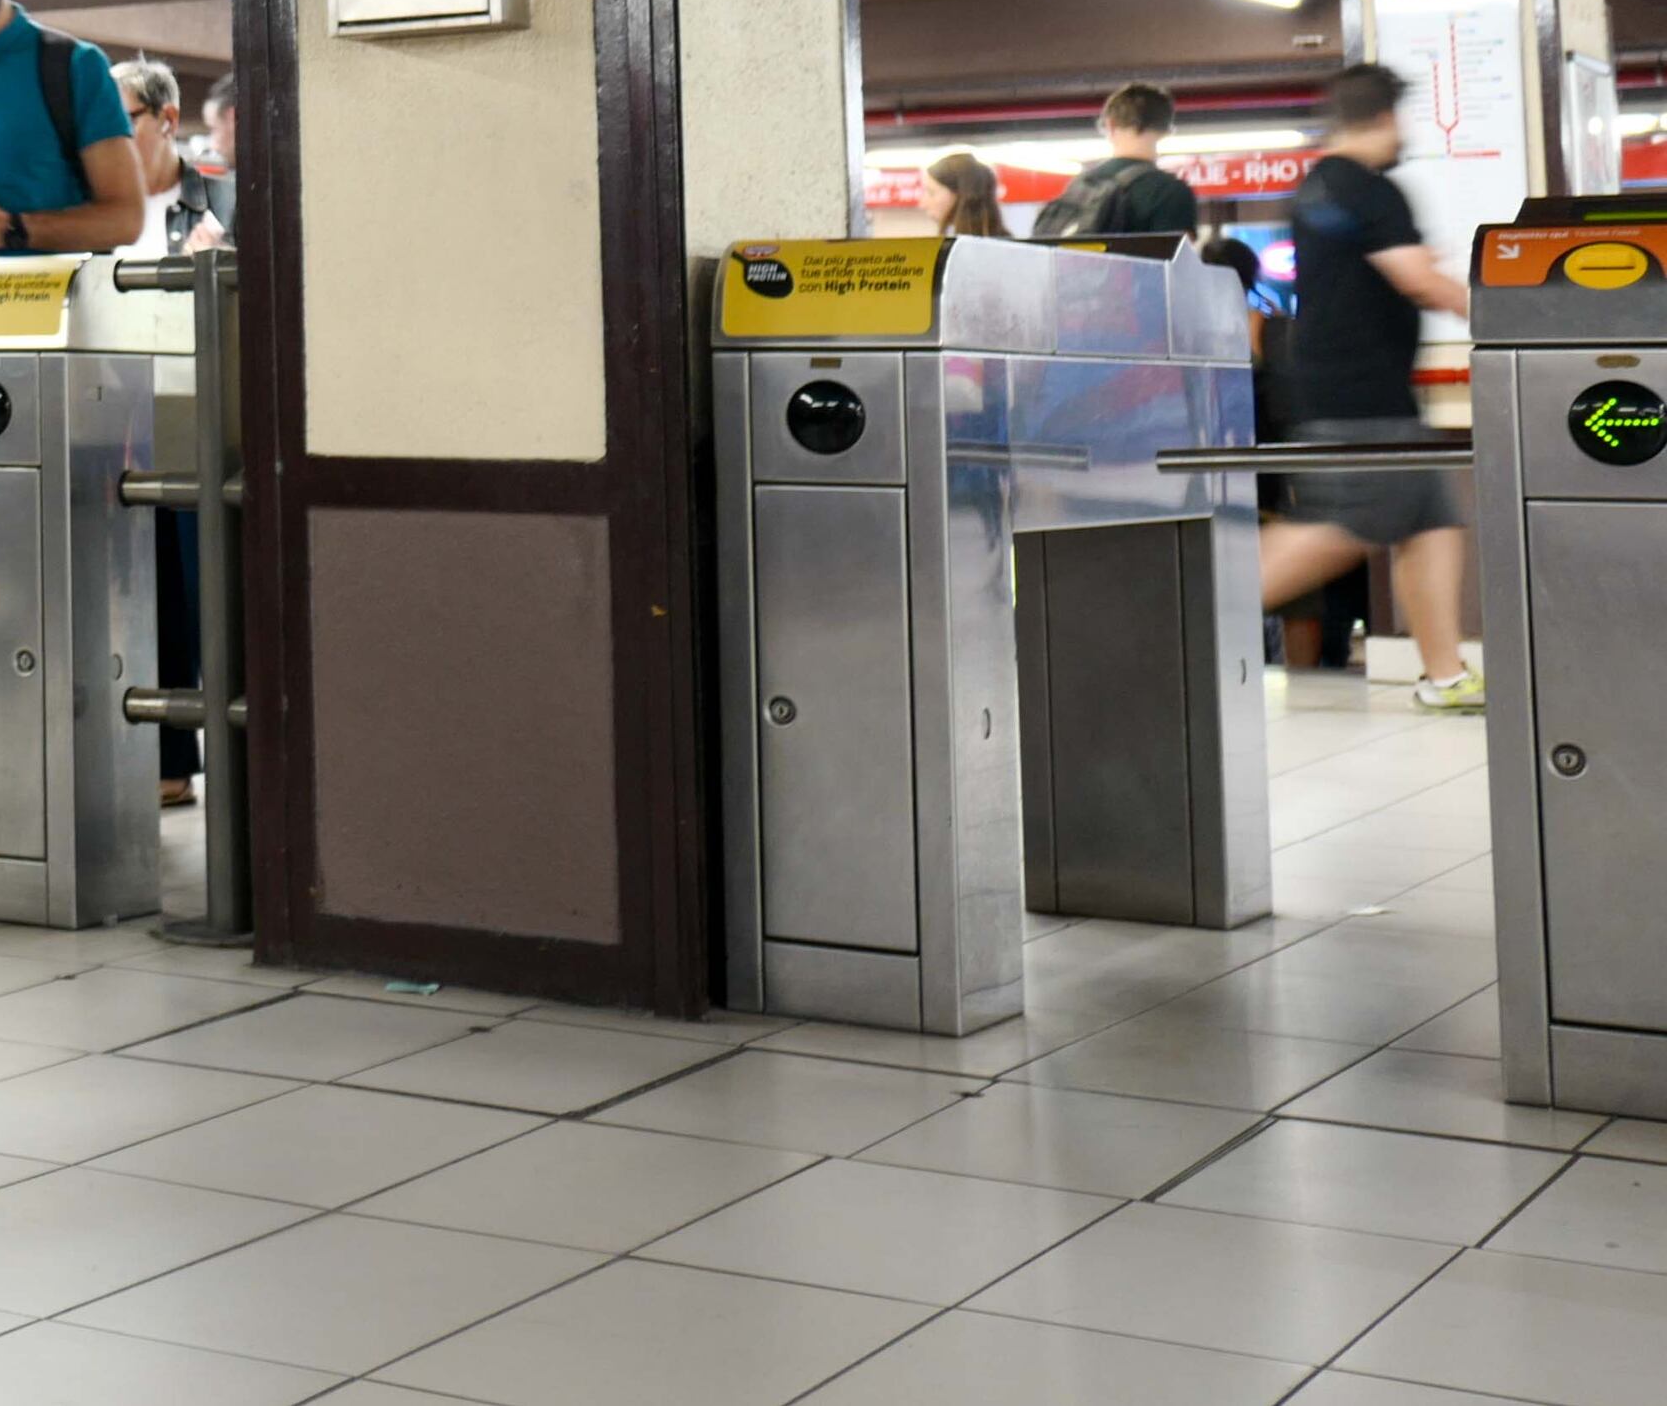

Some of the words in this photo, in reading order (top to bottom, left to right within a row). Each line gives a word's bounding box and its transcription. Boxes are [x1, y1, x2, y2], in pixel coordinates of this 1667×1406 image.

[749, 264, 779, 273] HIGH
[747, 272, 788, 282] PROTEIN
[799, 282, 822, 292] con
[825, 280, 856, 295] High
[859, 279, 911, 292] Protein
